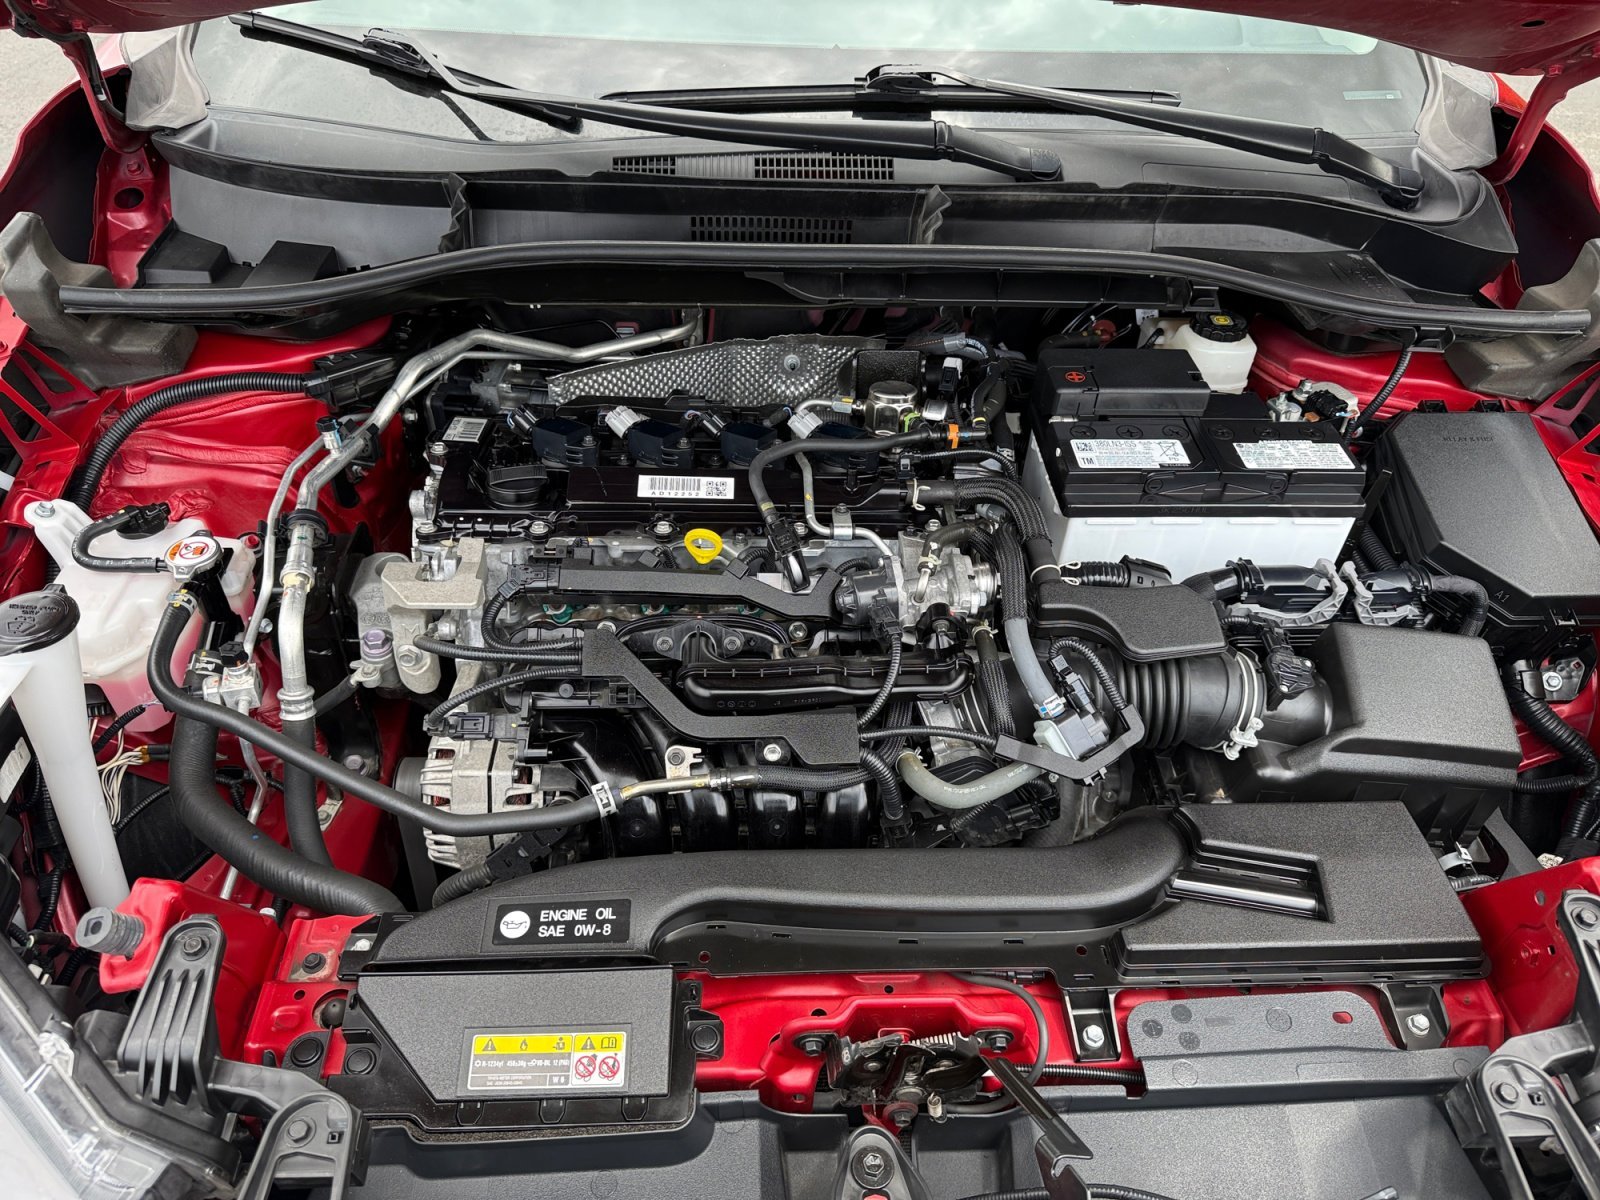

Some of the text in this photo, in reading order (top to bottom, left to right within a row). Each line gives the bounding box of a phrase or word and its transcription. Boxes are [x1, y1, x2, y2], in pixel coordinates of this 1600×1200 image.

[1081, 457, 1095, 465] TM
[539, 907, 617, 922] ENGINE OIL
[537, 923, 612, 938] SAE 0W-8
